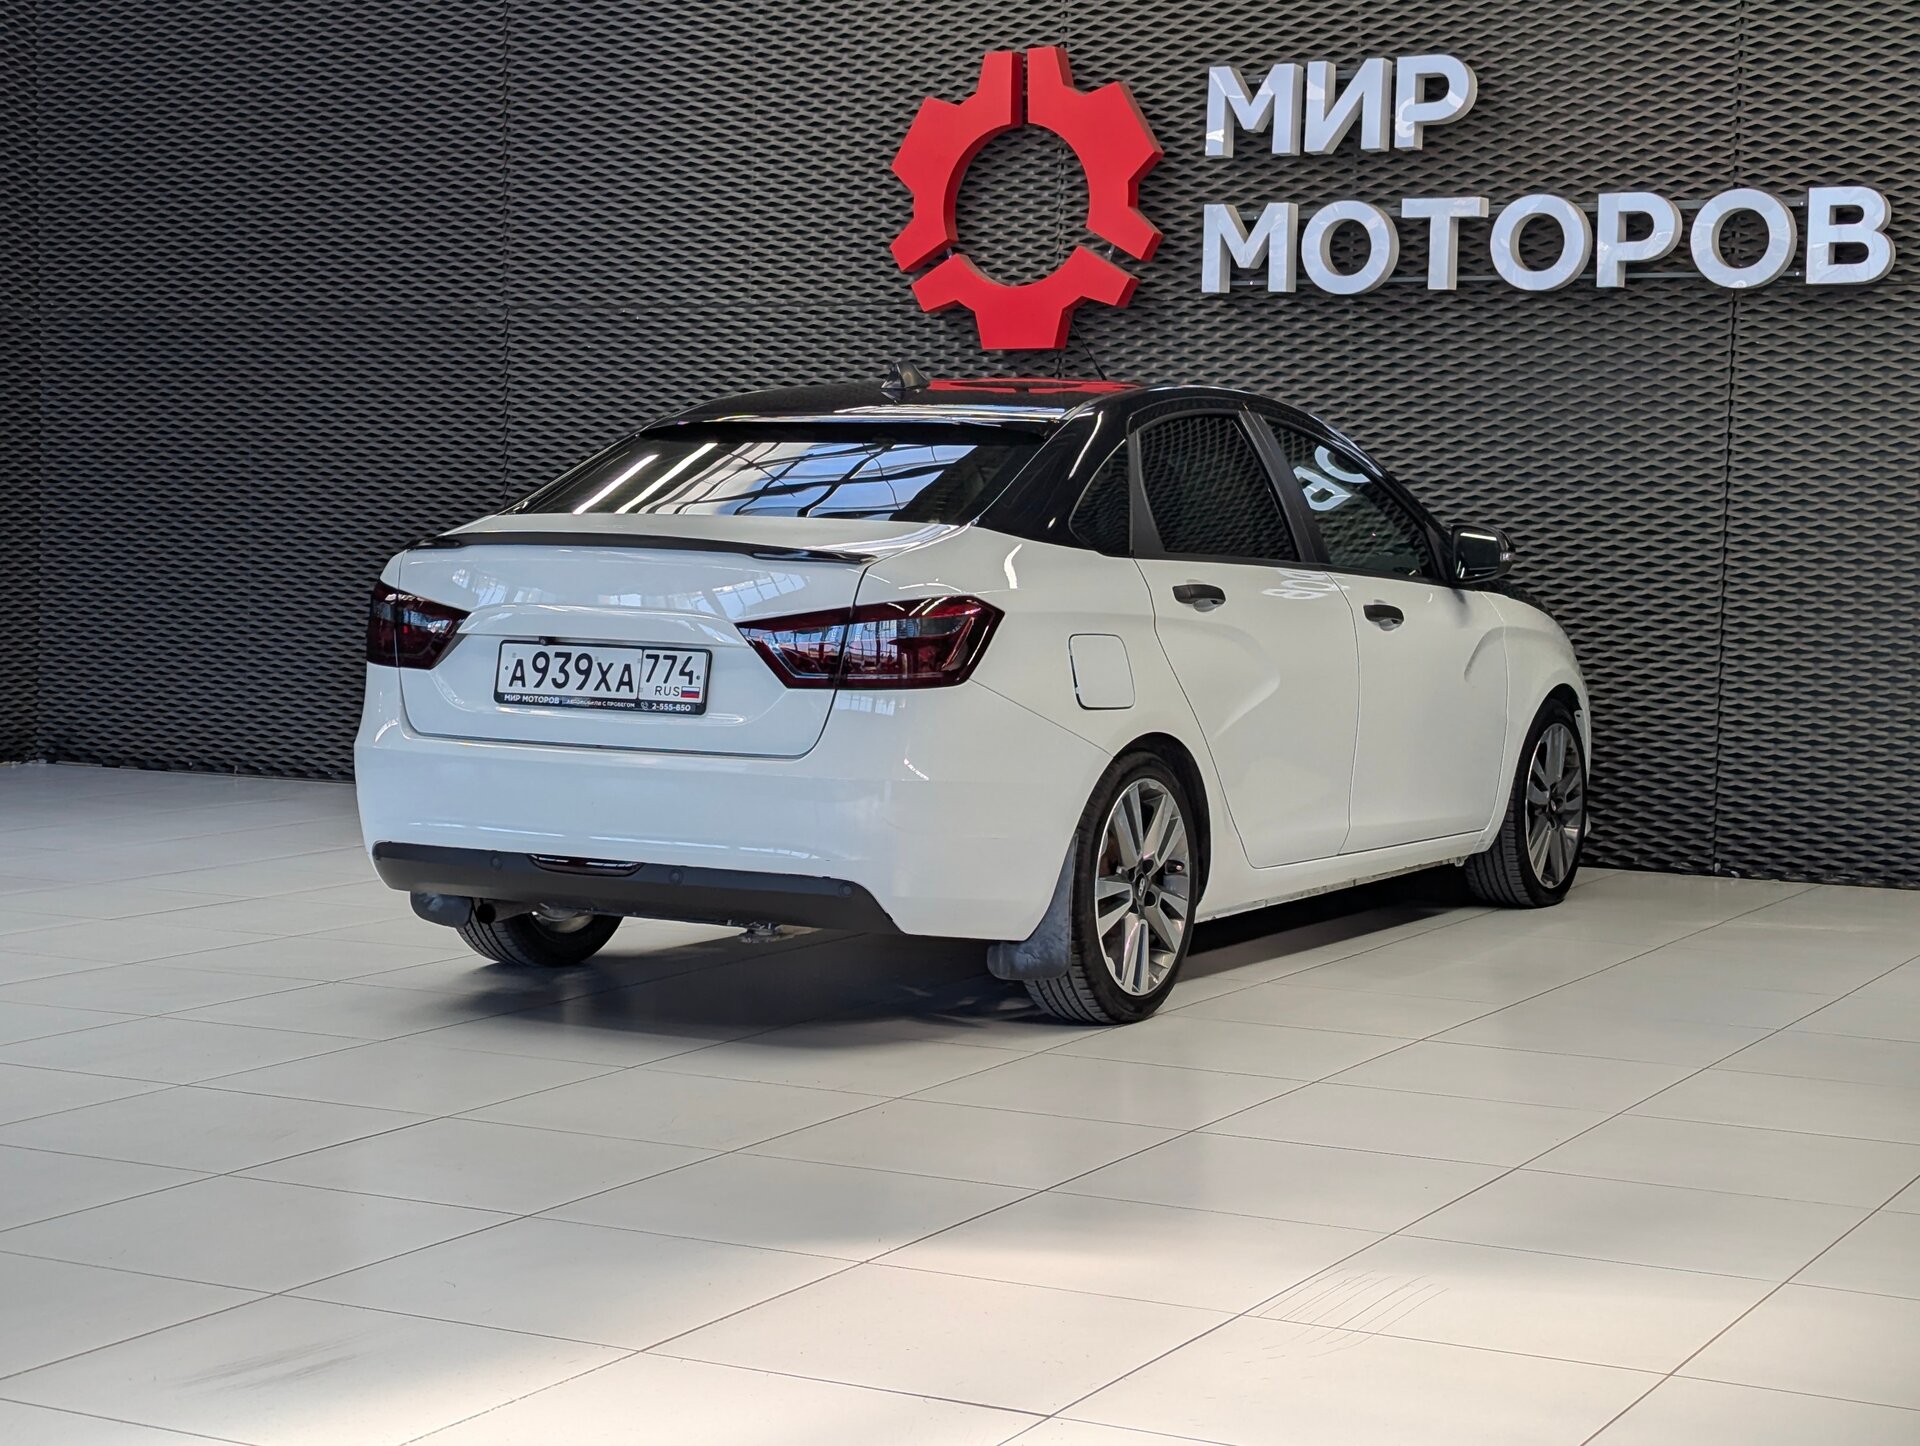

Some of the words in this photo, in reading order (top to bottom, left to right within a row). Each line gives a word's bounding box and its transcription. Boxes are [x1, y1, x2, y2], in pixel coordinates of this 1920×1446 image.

[1205, 54, 1478, 157] МИР
[1201, 186, 1896, 294] МОТОРОВ
[508, 651, 634, 693] А939ХА
[645, 654, 694, 685] 774
[654, 685, 680, 697] RUS
[504, 694, 520, 702] МИР
[522, 695, 560, 704] МОТОРОВ
